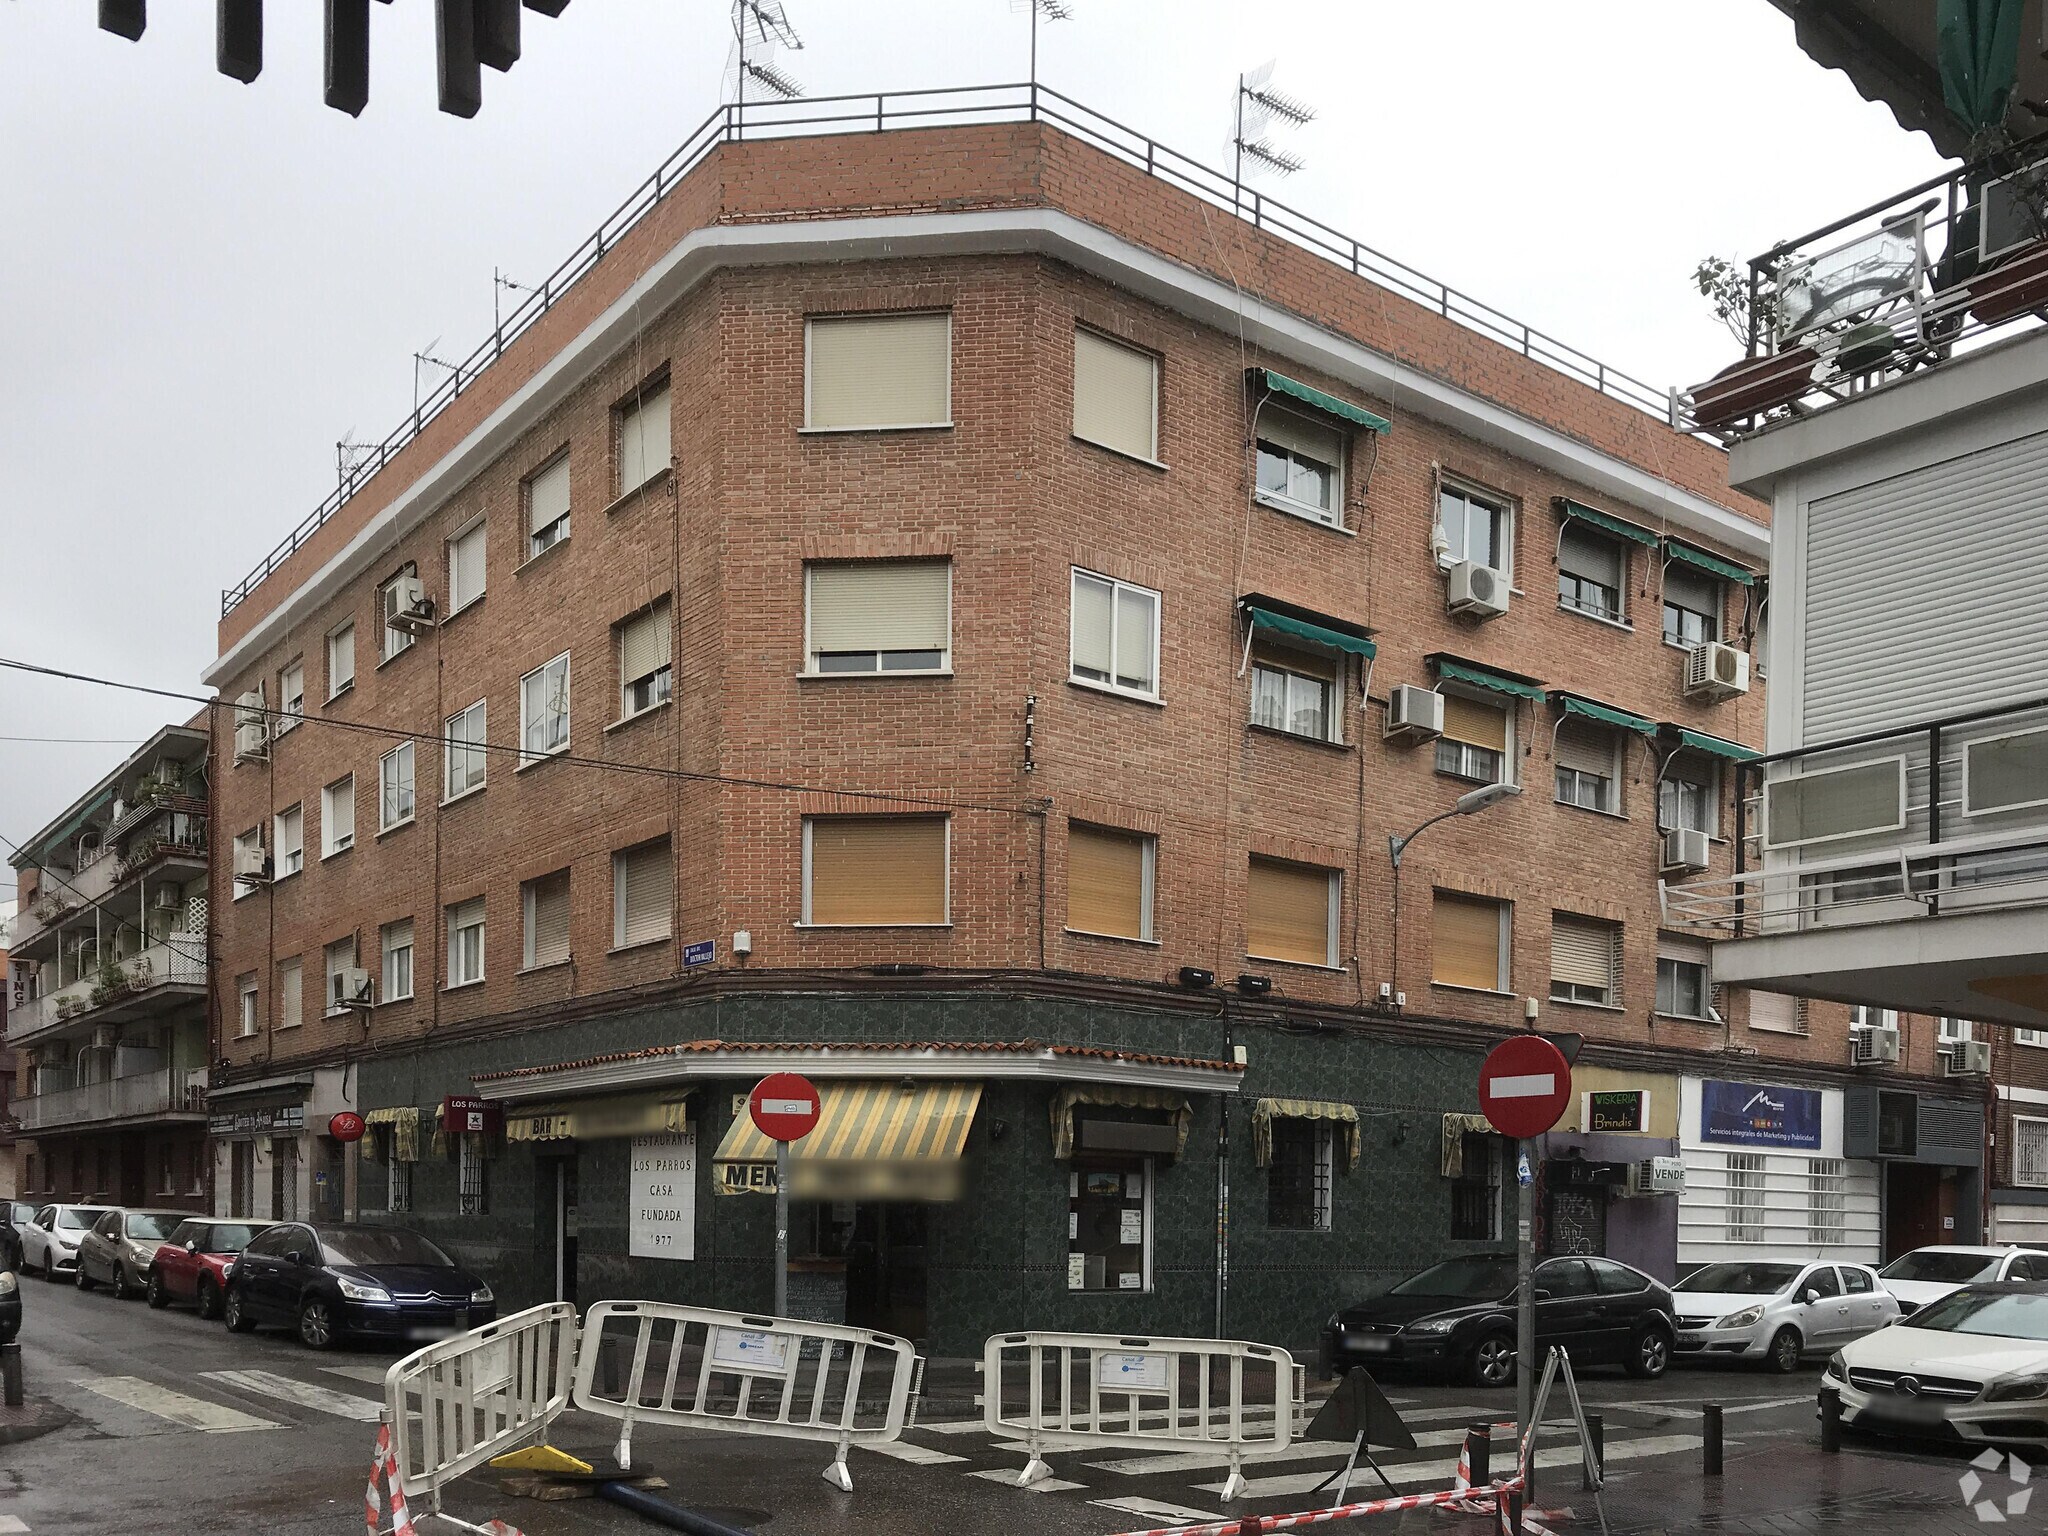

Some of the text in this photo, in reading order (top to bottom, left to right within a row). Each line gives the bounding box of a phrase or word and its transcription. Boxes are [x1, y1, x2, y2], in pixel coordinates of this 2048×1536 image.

[451, 1100, 499, 1109] LOS PARROS
[532, 1118, 551, 1134] BAR
[1595, 1113, 1632, 1129] Brindis
[632, 1133, 695, 1147] RESTAURANTE
[1709, 1127, 1731, 1136] Servicios
[1732, 1128, 1756, 1138] integrales
[1763, 1131, 1787, 1140] Marketing
[1791, 1133, 1815, 1141] Publicidad
[634, 1159, 692, 1171] LOS PARROS
[1655, 1168, 1685, 1180] VENDE
[650, 1184, 673, 1196] CASA
[641, 1209, 682, 1221] FUNDADA
[650, 1234, 672, 1246] 1977
